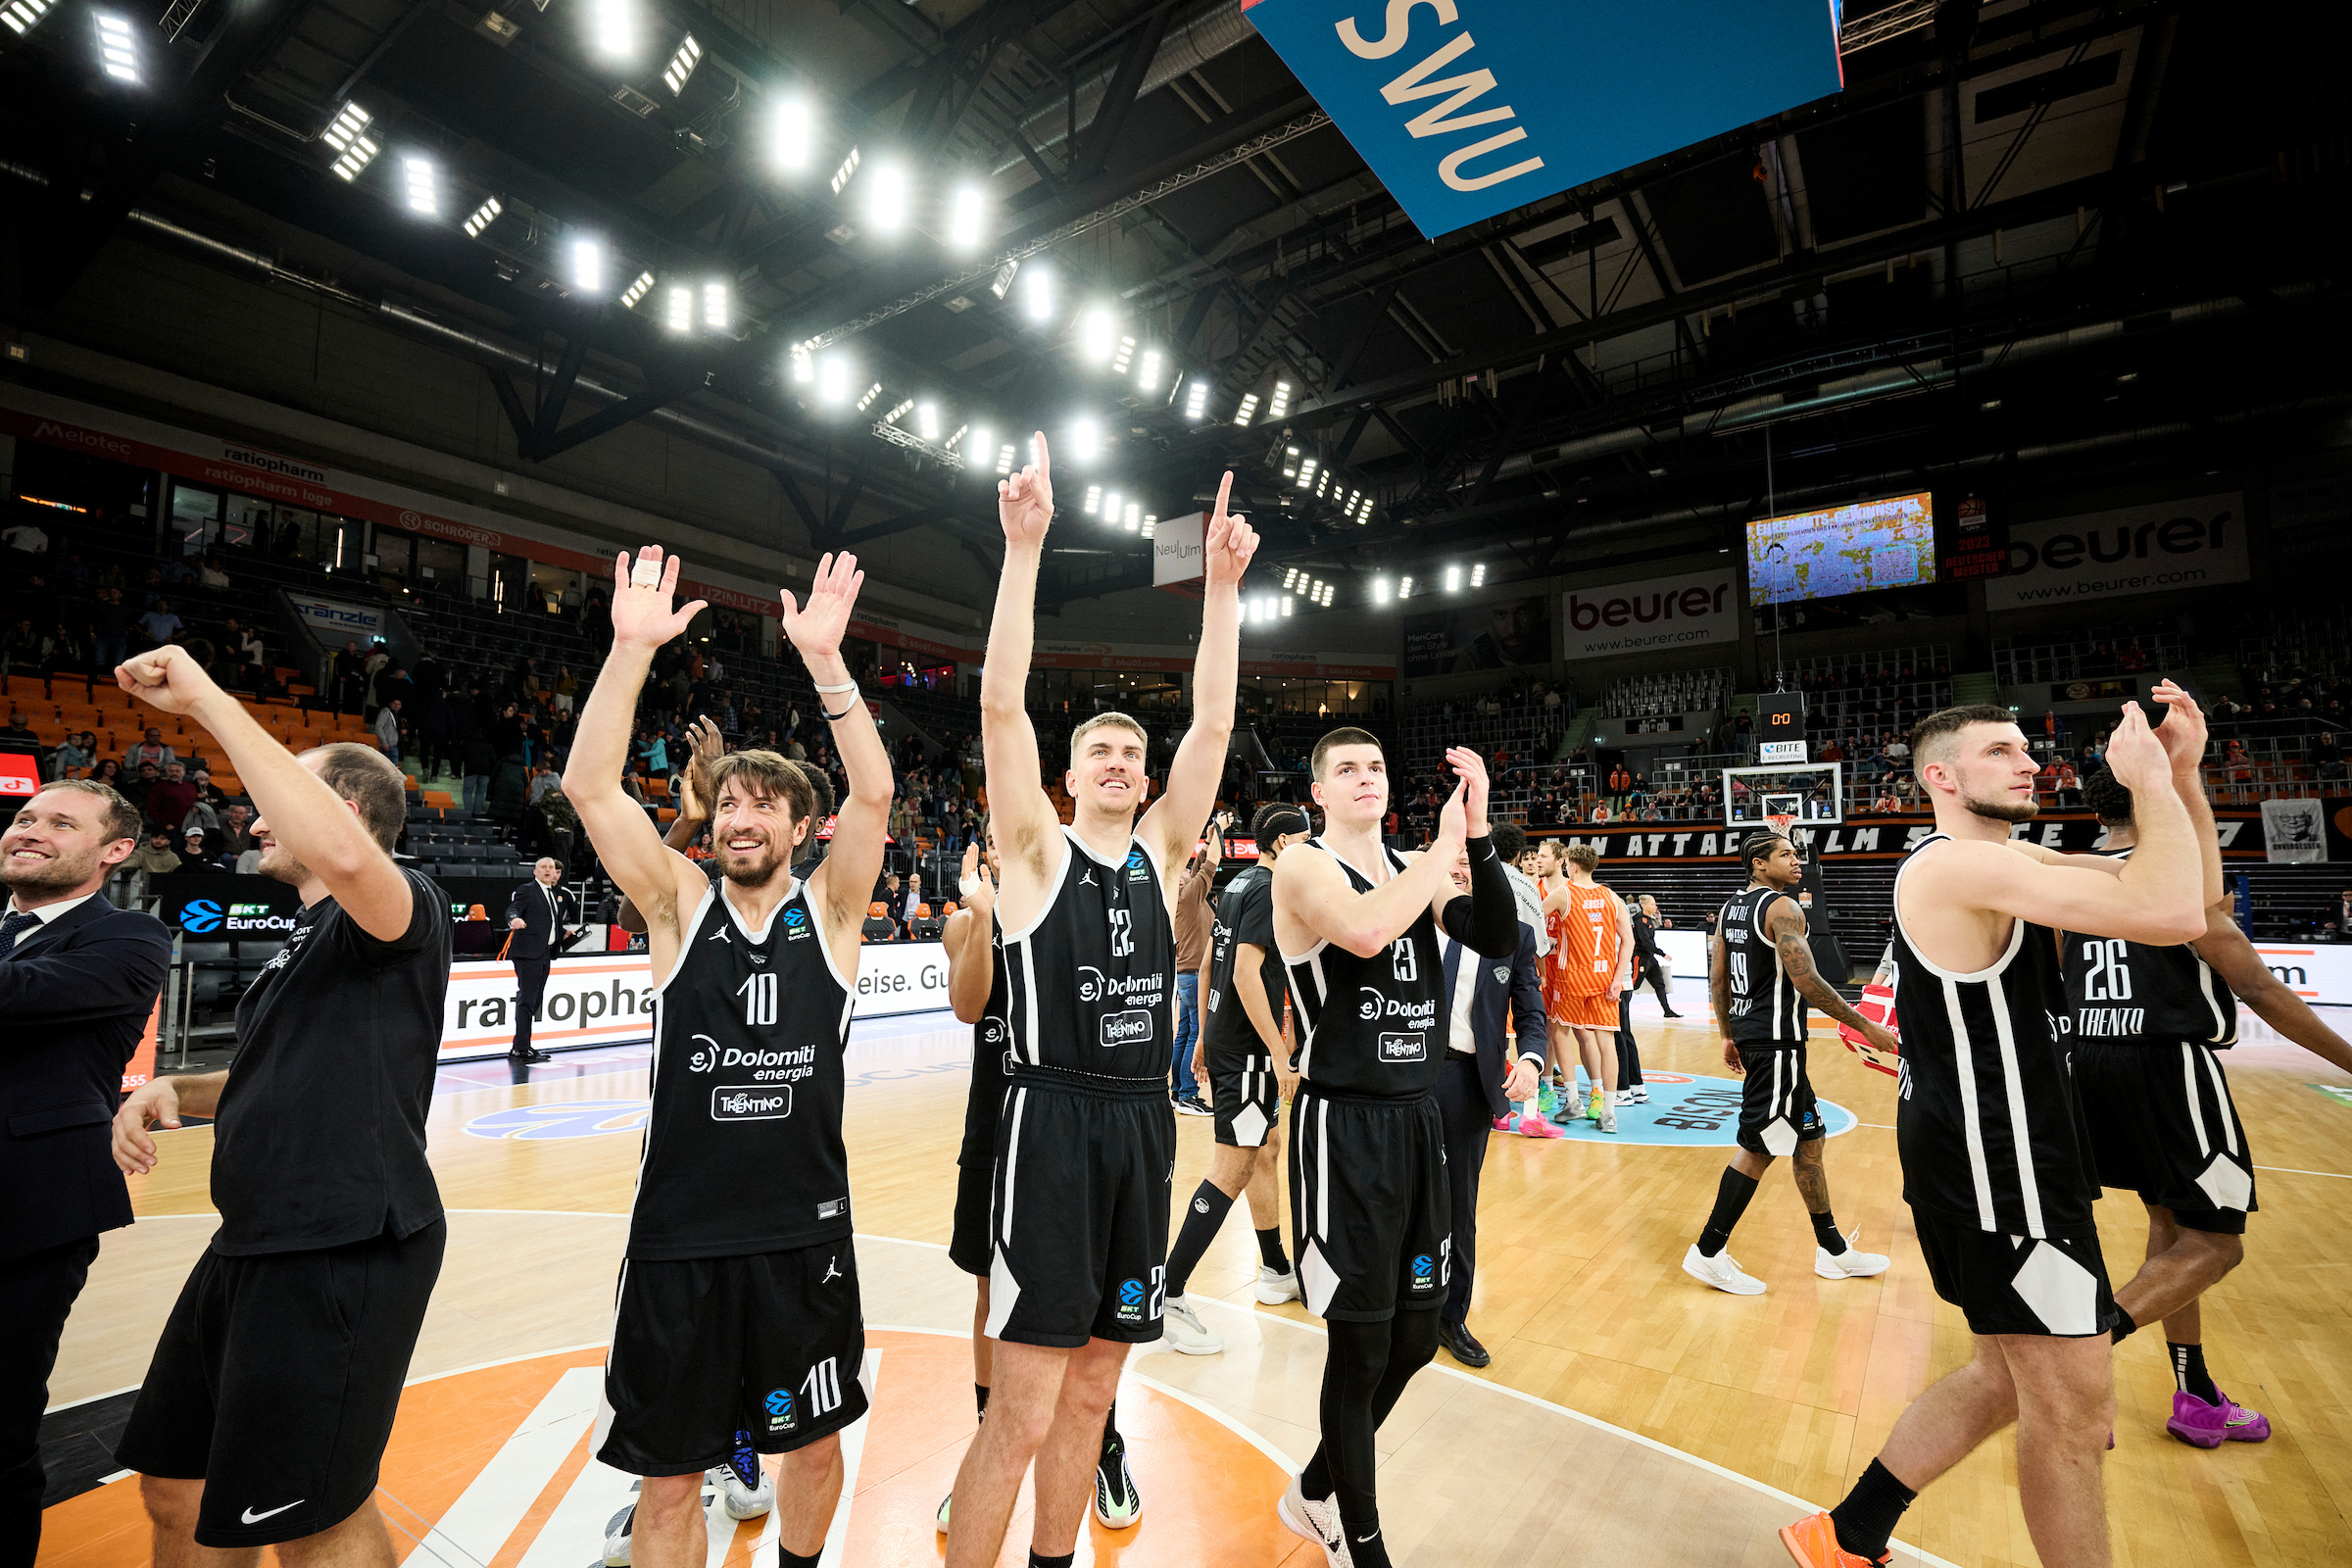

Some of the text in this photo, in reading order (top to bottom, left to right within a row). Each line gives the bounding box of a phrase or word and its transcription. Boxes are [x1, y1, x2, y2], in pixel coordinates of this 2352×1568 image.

[1334, 0, 1544, 192] SWU
[33, 420, 131, 456] Melotec
[223, 446, 324, 482] ratiopharm
[204, 466, 333, 507] ratiopharm loge
[1958, 535, 1991, 551] 2023
[1945, 549, 2006, 568] DEUTSCHER
[1953, 562, 2000, 578] MEISTER
[2018, 567, 2206, 602] www.beurer.com
[1570, 582, 1728, 631] beurer
[857, 611, 899, 629] ratiopharm
[1407, 630, 1446, 643] MenCare
[1585, 628, 1710, 653] www.beurer.com
[1271, 652, 1317, 662] ratiopharm
[1776, 743, 1801, 753] BITE
[1626, 831, 1740, 857] ATTAC
[228, 905, 270, 914] BKT
[1582, 899, 1605, 909] JENSEN
[226, 915, 296, 931] EuroCup
[1592, 926, 1603, 956] 7
[1593, 959, 1607, 973] ULM
[1731, 951, 1749, 995] 99
[2082, 939, 2132, 1001] 26
[736, 972, 777, 1026] 10
[2079, 1007, 2145, 1037] TRENTO
[721, 1044, 816, 1067] Dolomiti
[753, 1064, 813, 1082] energia
[720, 1095, 784, 1114] TRENTINO
[1116, 1311, 1142, 1322] EuroCup
[800, 1355, 842, 1418] 10
[768, 1422, 796, 1432] EuroCup
